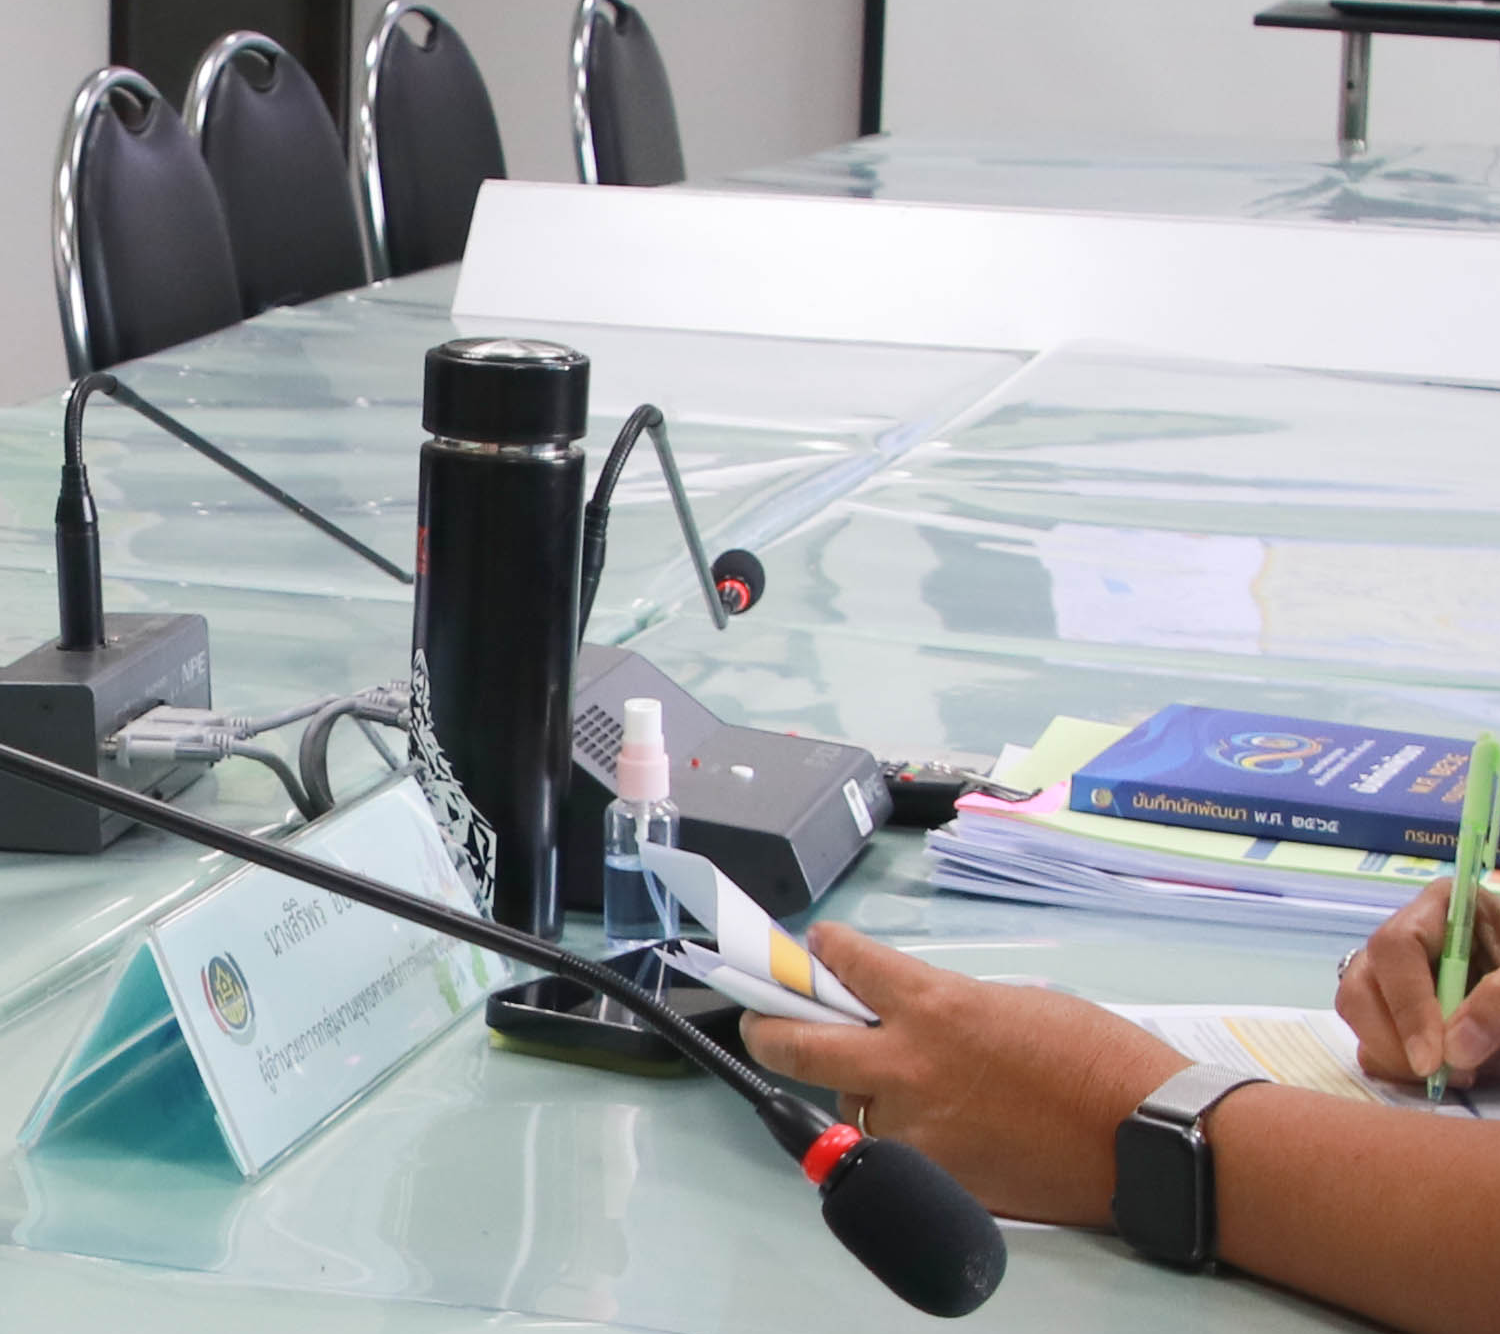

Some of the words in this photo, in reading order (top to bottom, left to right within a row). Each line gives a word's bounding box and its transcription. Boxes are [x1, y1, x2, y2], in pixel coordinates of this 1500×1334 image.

[1132, 790, 1248, 823] บันทึกนักพัฒนา
[1253, 807, 1284, 827] พ.ศ.
[1291, 816, 1341, 835] ๒๕๖๕
